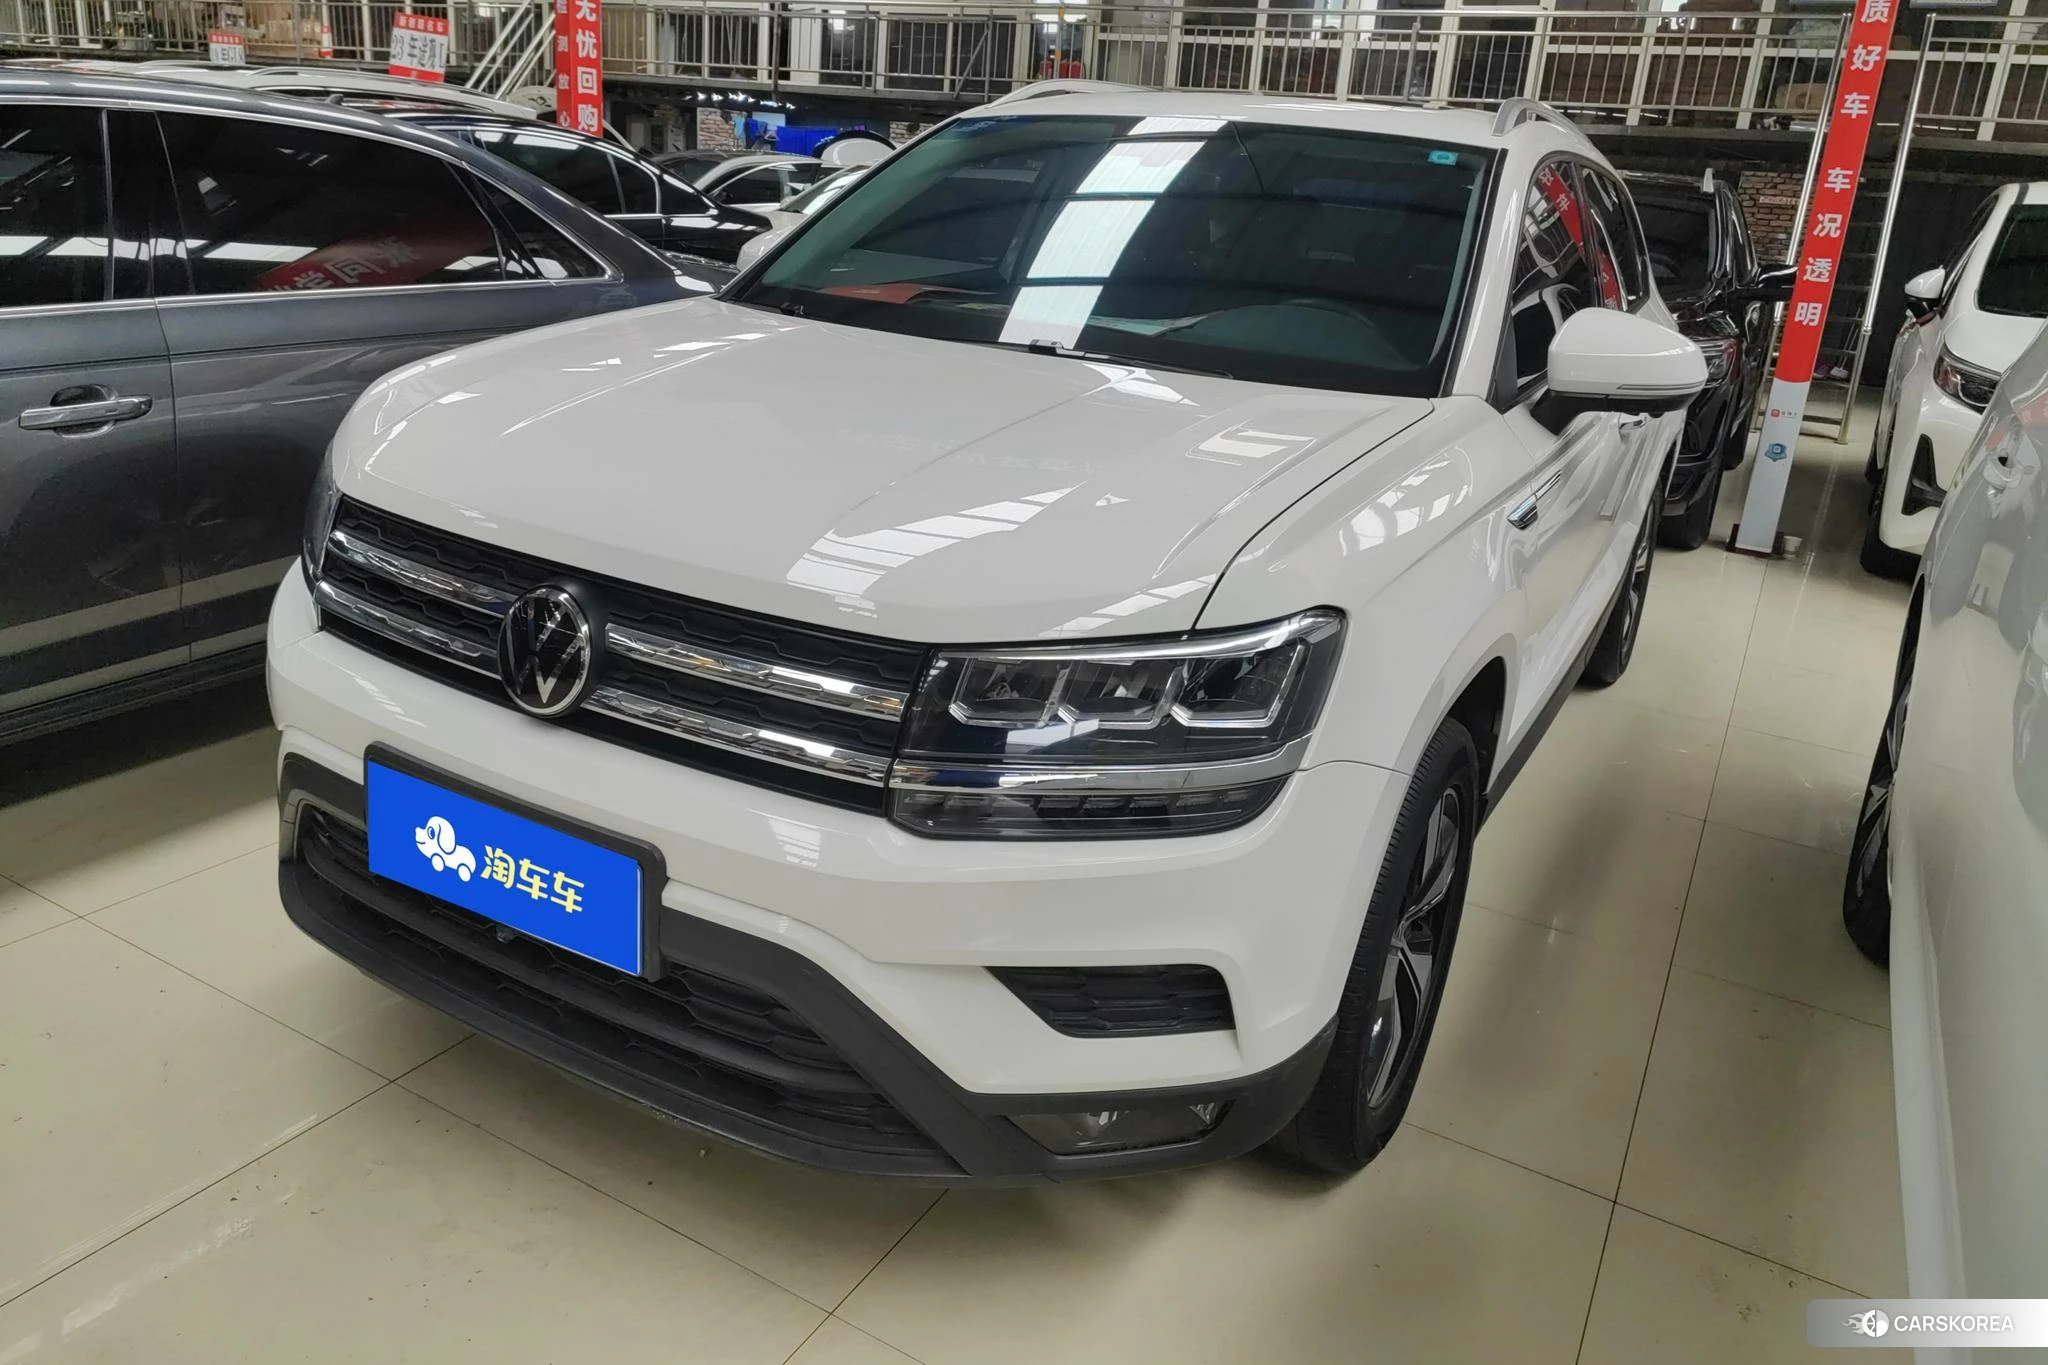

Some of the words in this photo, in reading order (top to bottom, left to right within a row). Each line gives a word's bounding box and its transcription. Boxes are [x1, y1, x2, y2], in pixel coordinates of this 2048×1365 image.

[575, 0, 598, 132] 无忧回购
[1794, 167, 1853, 327] 车况透明
